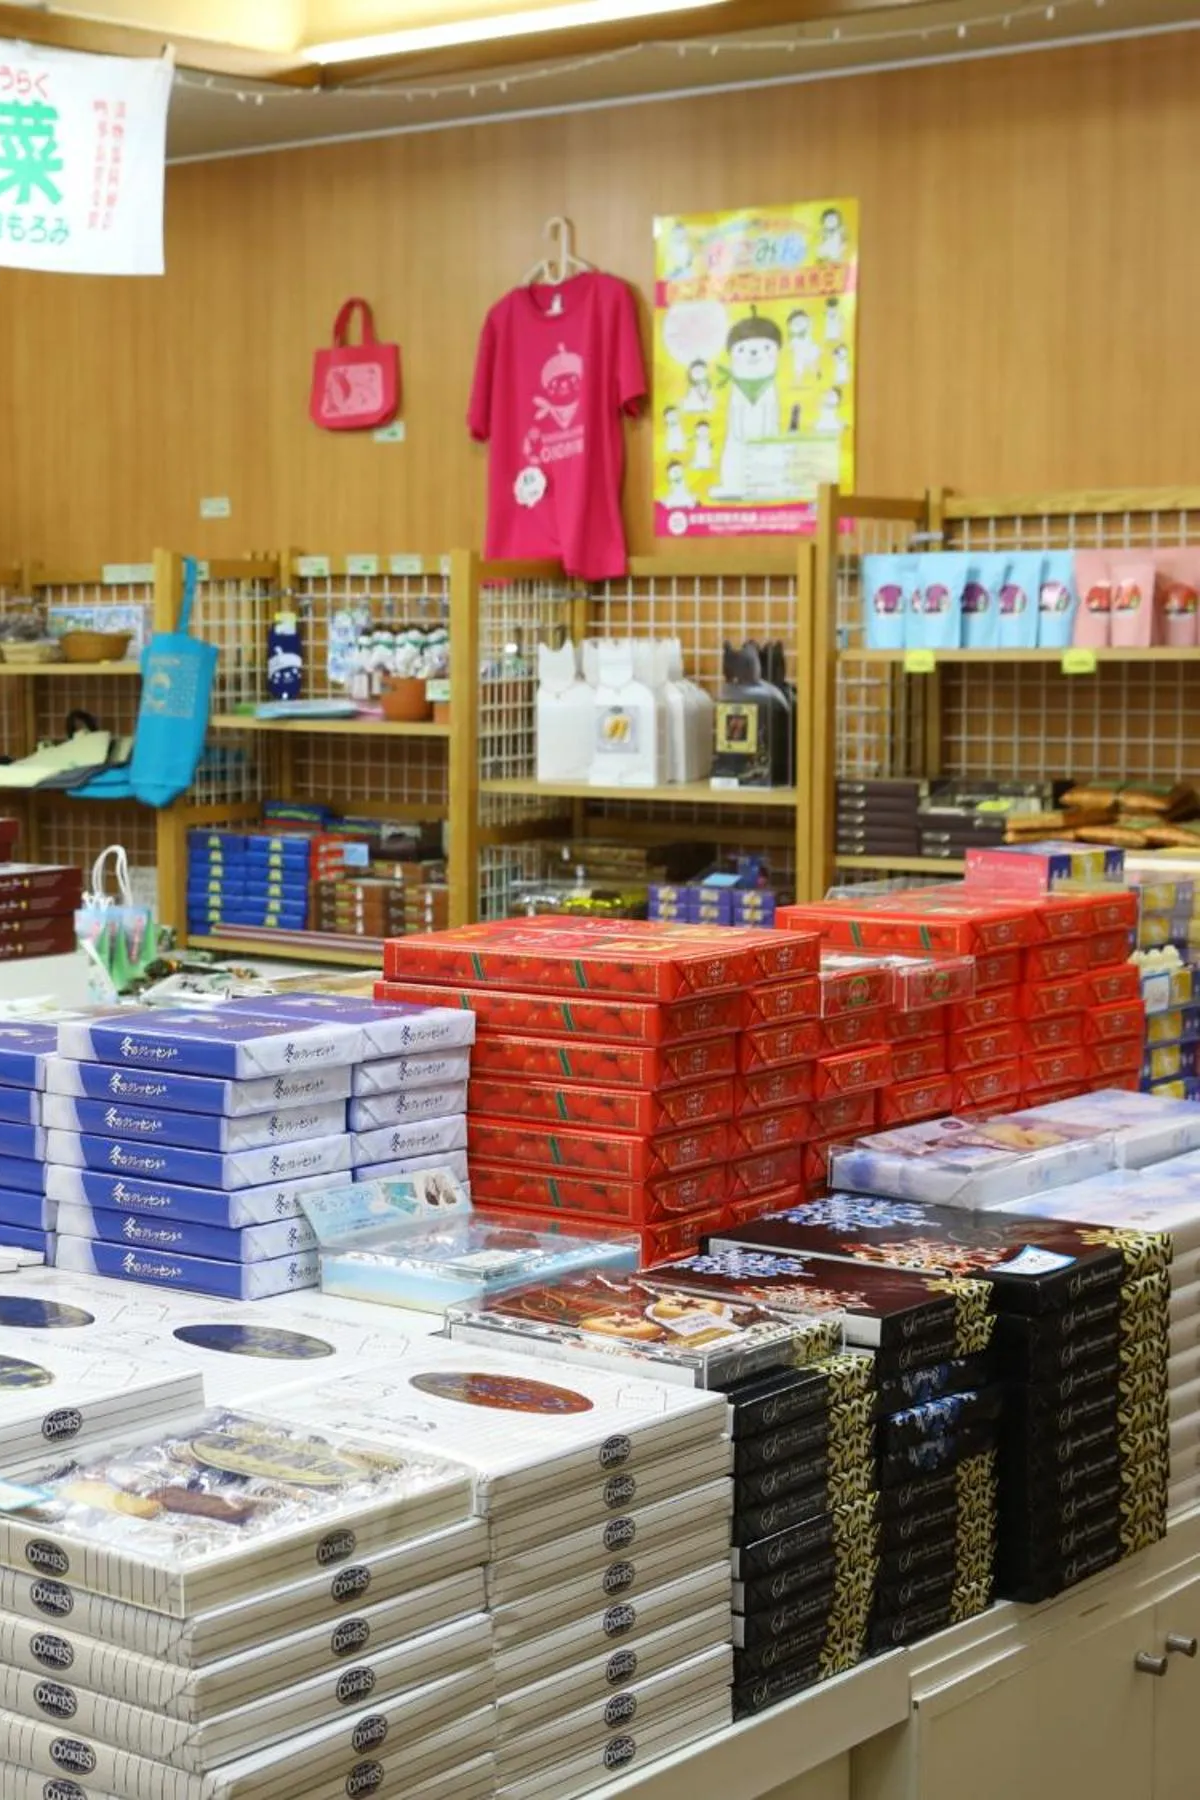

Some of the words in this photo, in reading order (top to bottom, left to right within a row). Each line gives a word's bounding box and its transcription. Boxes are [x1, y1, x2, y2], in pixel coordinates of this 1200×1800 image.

[28, 1548, 68, 1571] COOKIES
[318, 1535, 356, 1561] COOKIES
[333, 1570, 370, 1596] COOKIES
[31, 1588, 74, 1611] COOKIES
[333, 1625, 369, 1650] COOKIES
[31, 1641, 74, 1664] COOKIES
[338, 1672, 375, 1698] COOKIES
[34, 1689, 77, 1713] COOKIES
[51, 1745, 95, 1768] COOKIES
[347, 1765, 383, 1791] COOKIES
